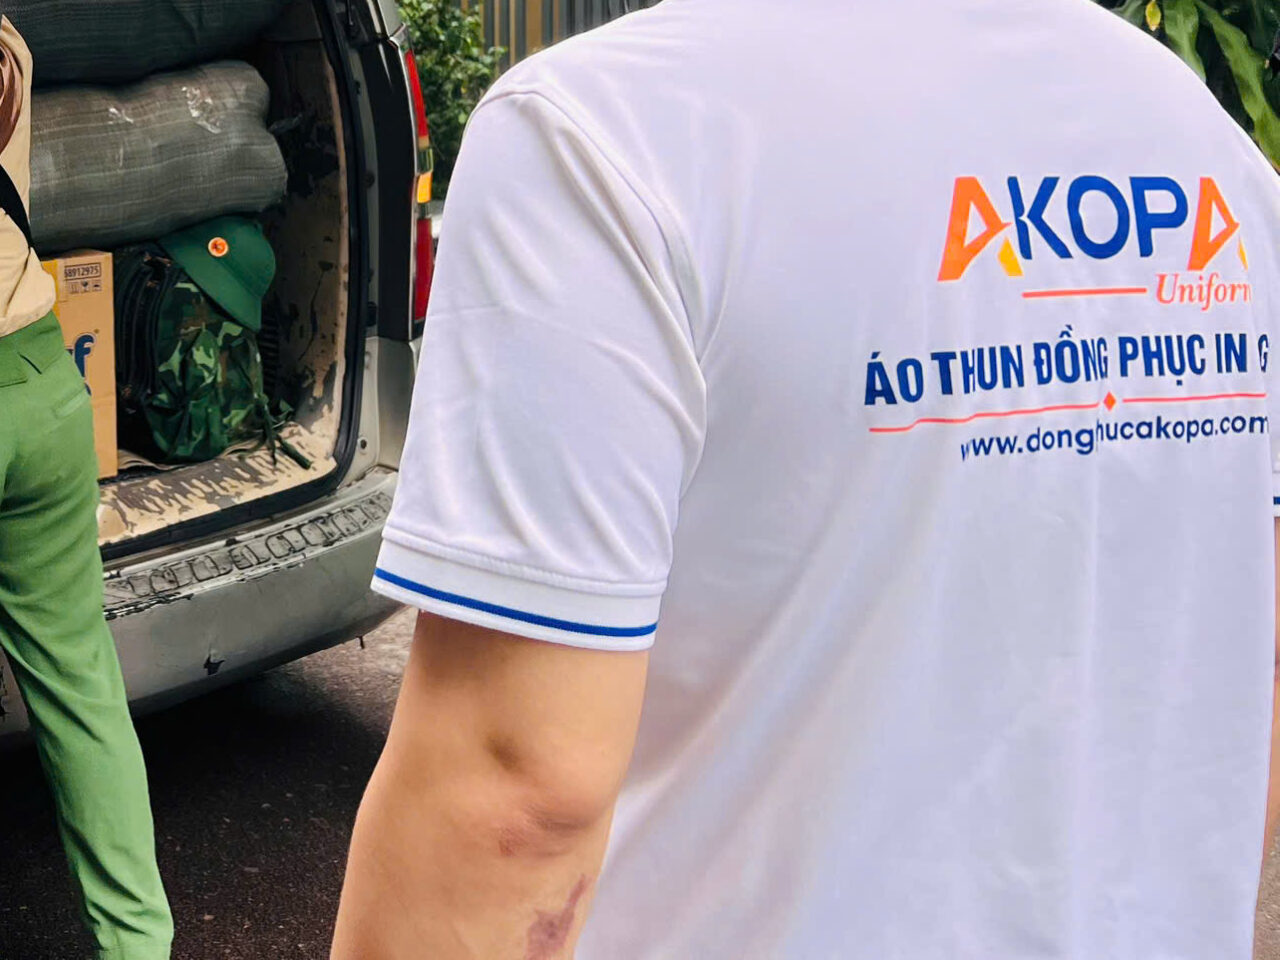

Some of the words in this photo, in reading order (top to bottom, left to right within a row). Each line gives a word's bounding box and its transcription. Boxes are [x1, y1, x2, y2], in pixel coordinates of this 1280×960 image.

[937, 175, 1249, 282] AKOPA
[864, 351, 923, 406] ÁO
[931, 344, 1024, 396] THUN
[1033, 325, 1108, 385] ĐỒNG
[1118, 333, 1207, 387] PHỤC
[1215, 333, 1248, 374] IN
[961, 415, 1270, 462] www.donghucakopa.com
